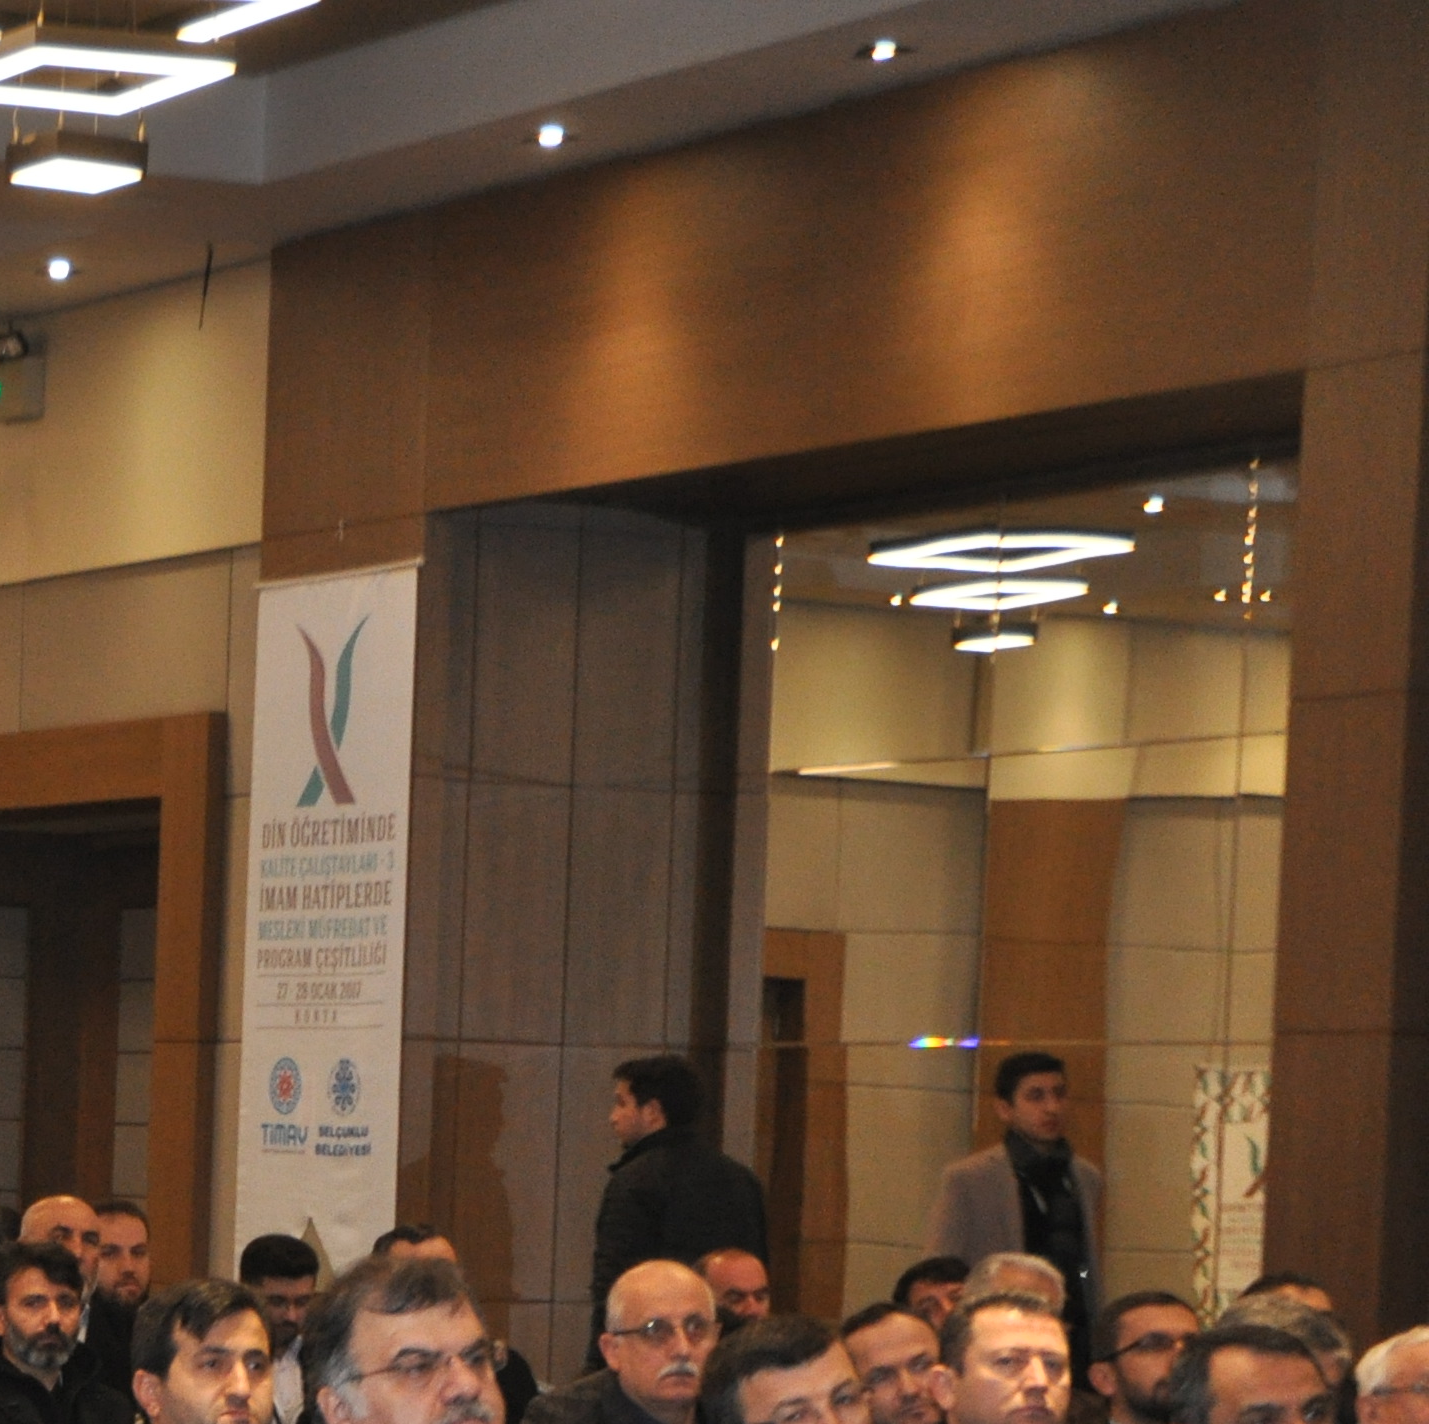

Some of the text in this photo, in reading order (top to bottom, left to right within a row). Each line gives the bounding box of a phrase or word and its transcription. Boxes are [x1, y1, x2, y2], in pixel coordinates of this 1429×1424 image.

[262, 812, 396, 848] DİN ÖĞRETİMİNDE
[260, 880, 392, 912] İMAM HATİPLERDE
[257, 947, 312, 969] PROGRAM
